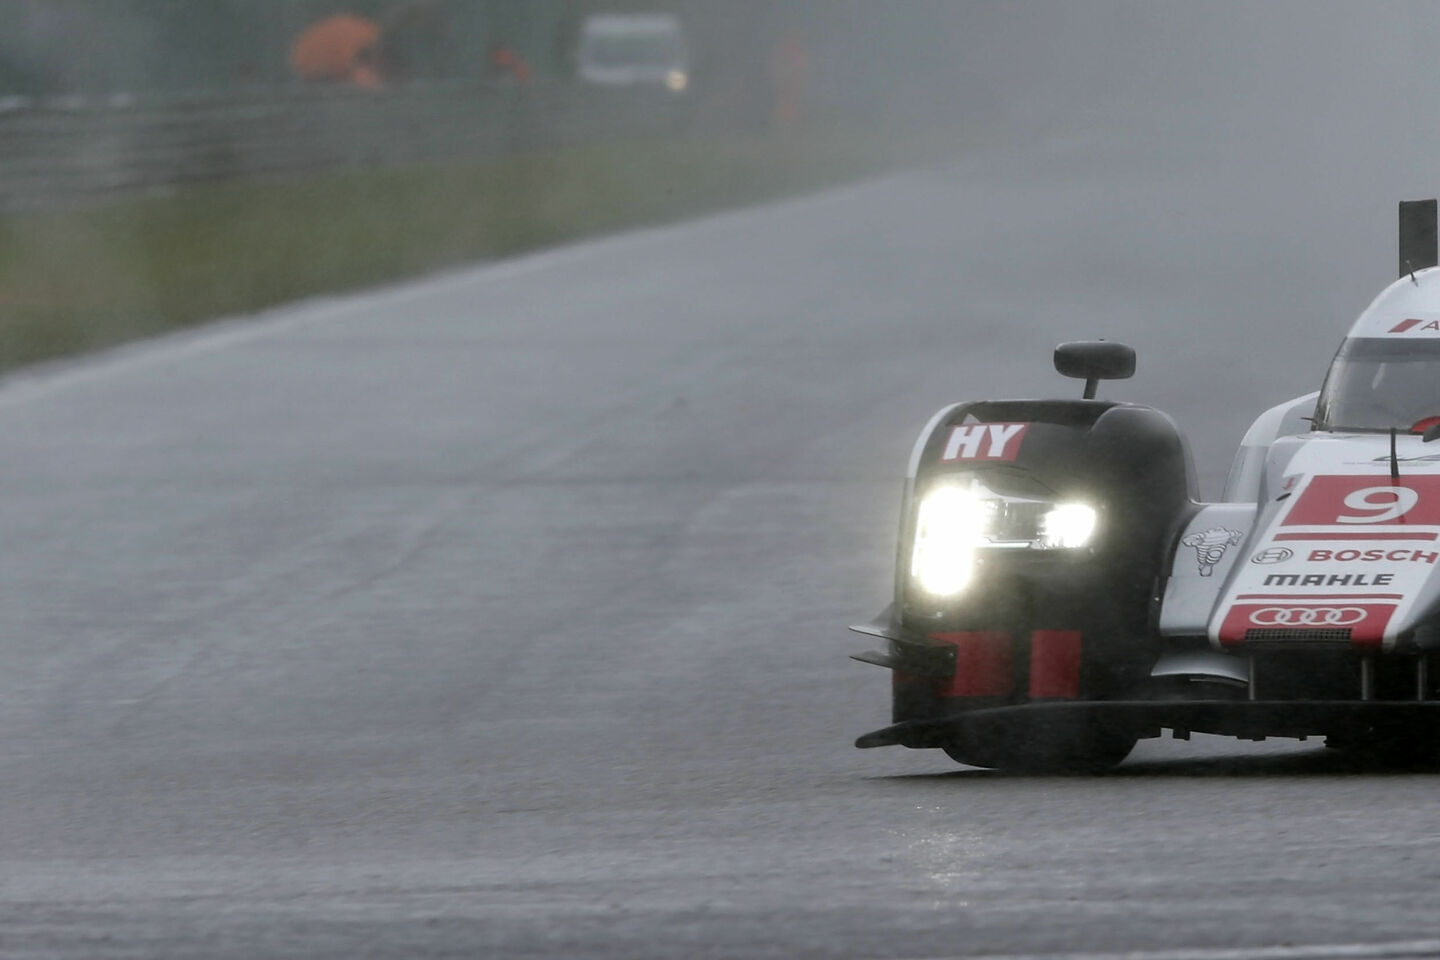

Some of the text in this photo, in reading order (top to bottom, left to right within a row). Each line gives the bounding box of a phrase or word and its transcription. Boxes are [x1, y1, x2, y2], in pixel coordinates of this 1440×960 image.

[943, 424, 1025, 460] HY
[1336, 486, 1418, 524] 9
[1306, 549, 1438, 564] BOSCH
[1262, 573, 1395, 587] MAHLE
